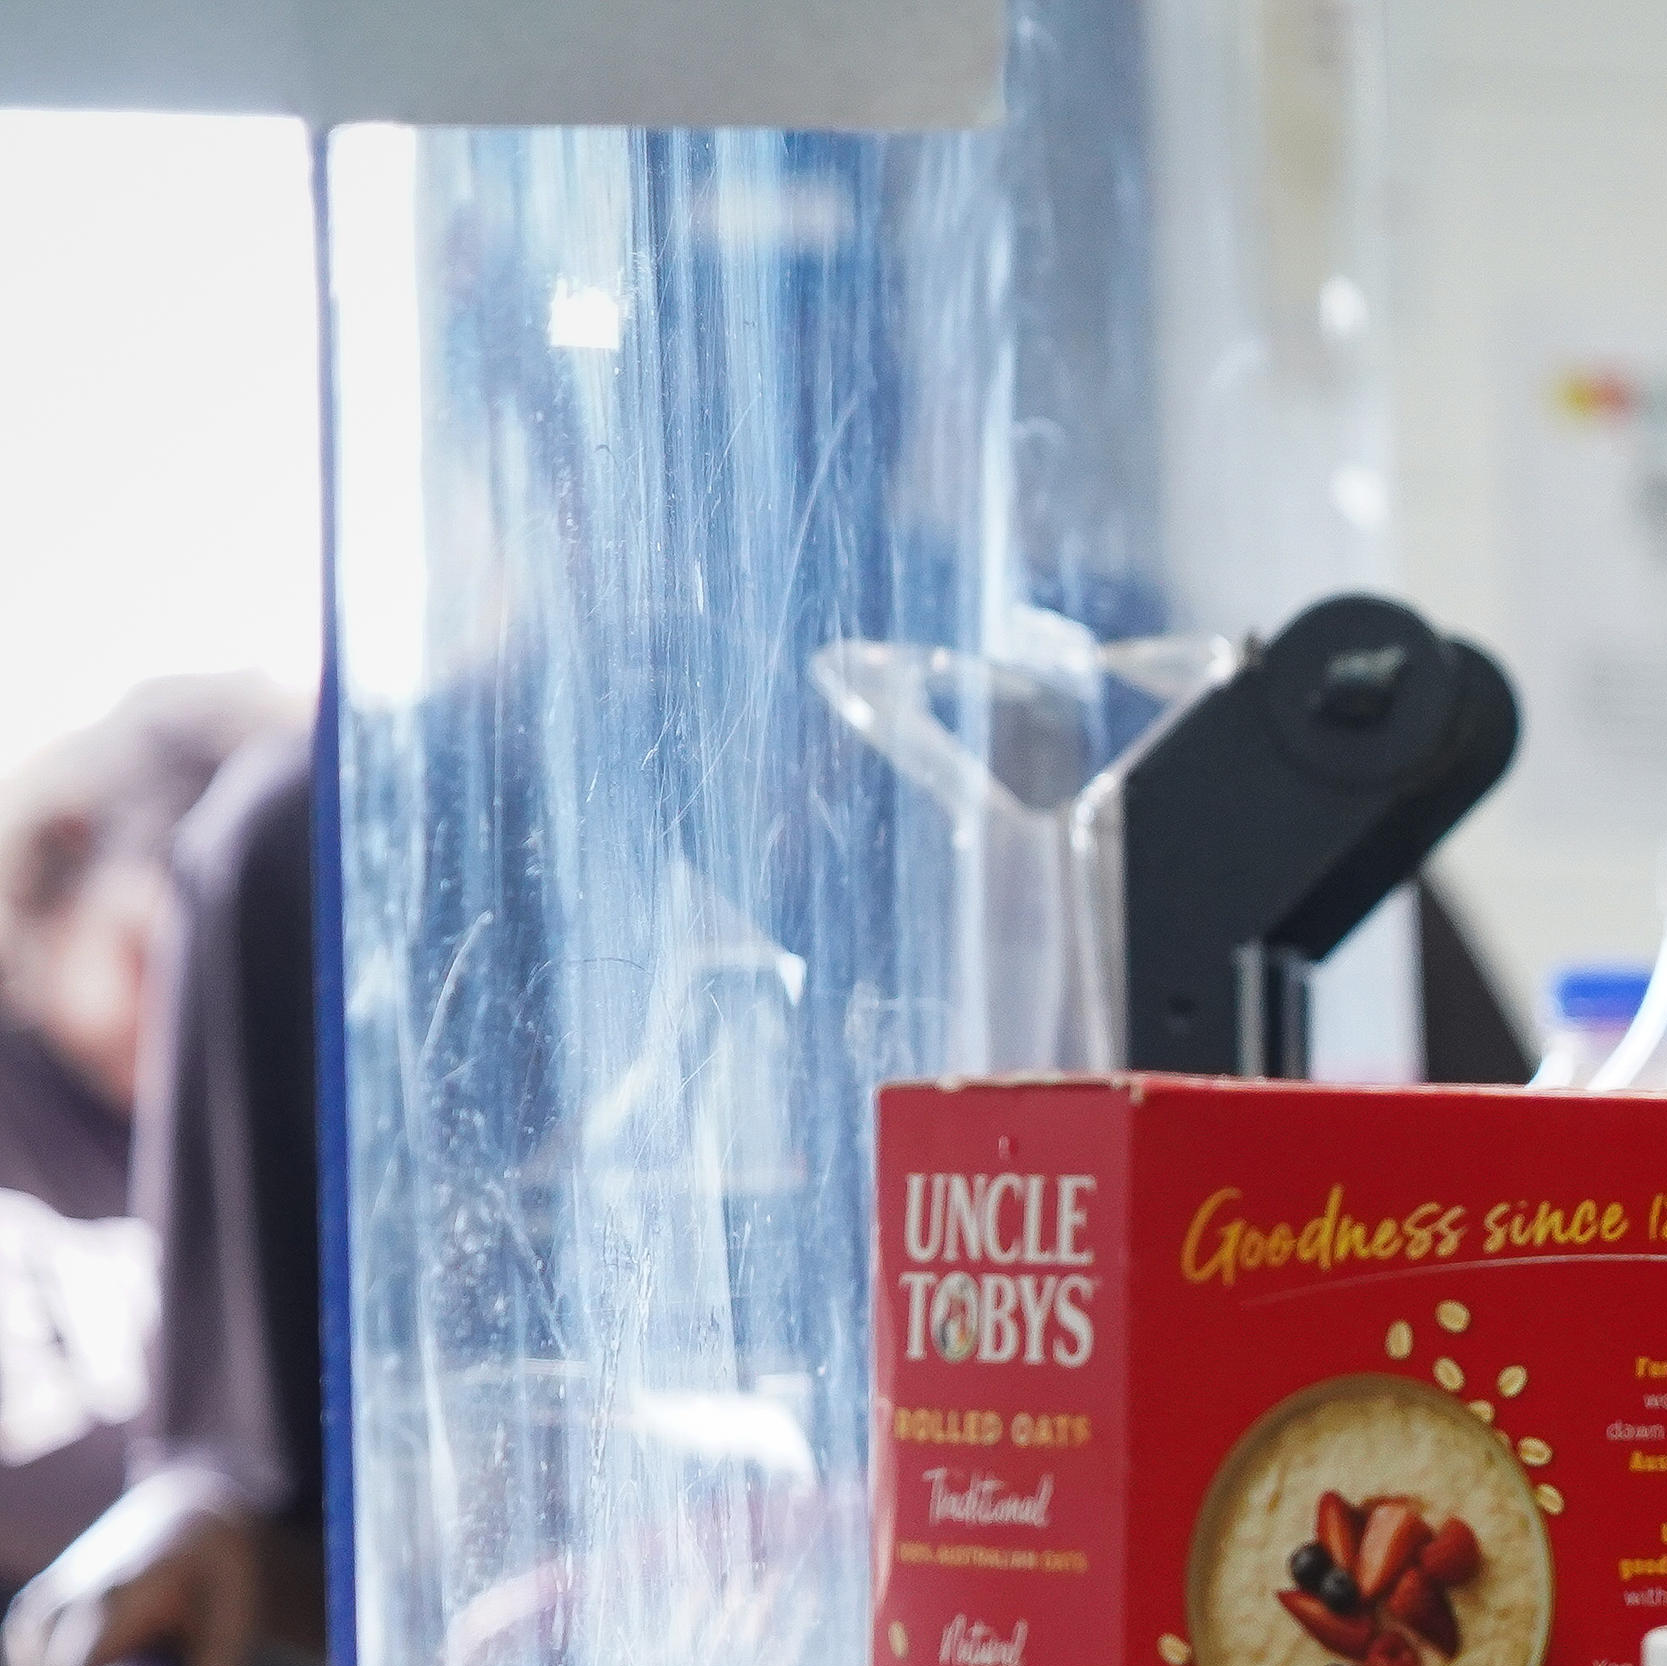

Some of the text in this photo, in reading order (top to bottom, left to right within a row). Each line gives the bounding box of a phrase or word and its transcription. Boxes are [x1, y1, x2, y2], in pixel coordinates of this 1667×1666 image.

[905, 1174, 1096, 1265] UNCLE
[1180, 1185, 1466, 1286] Goodness
[1483, 1199, 1628, 1253] since
[900, 1271, 1096, 1367] TOBYS
[894, 1408, 1092, 1449] ROLLED OATS
[1606, 1421, 1666, 1441] dawn
[921, 1467, 1055, 1529] Traditional
